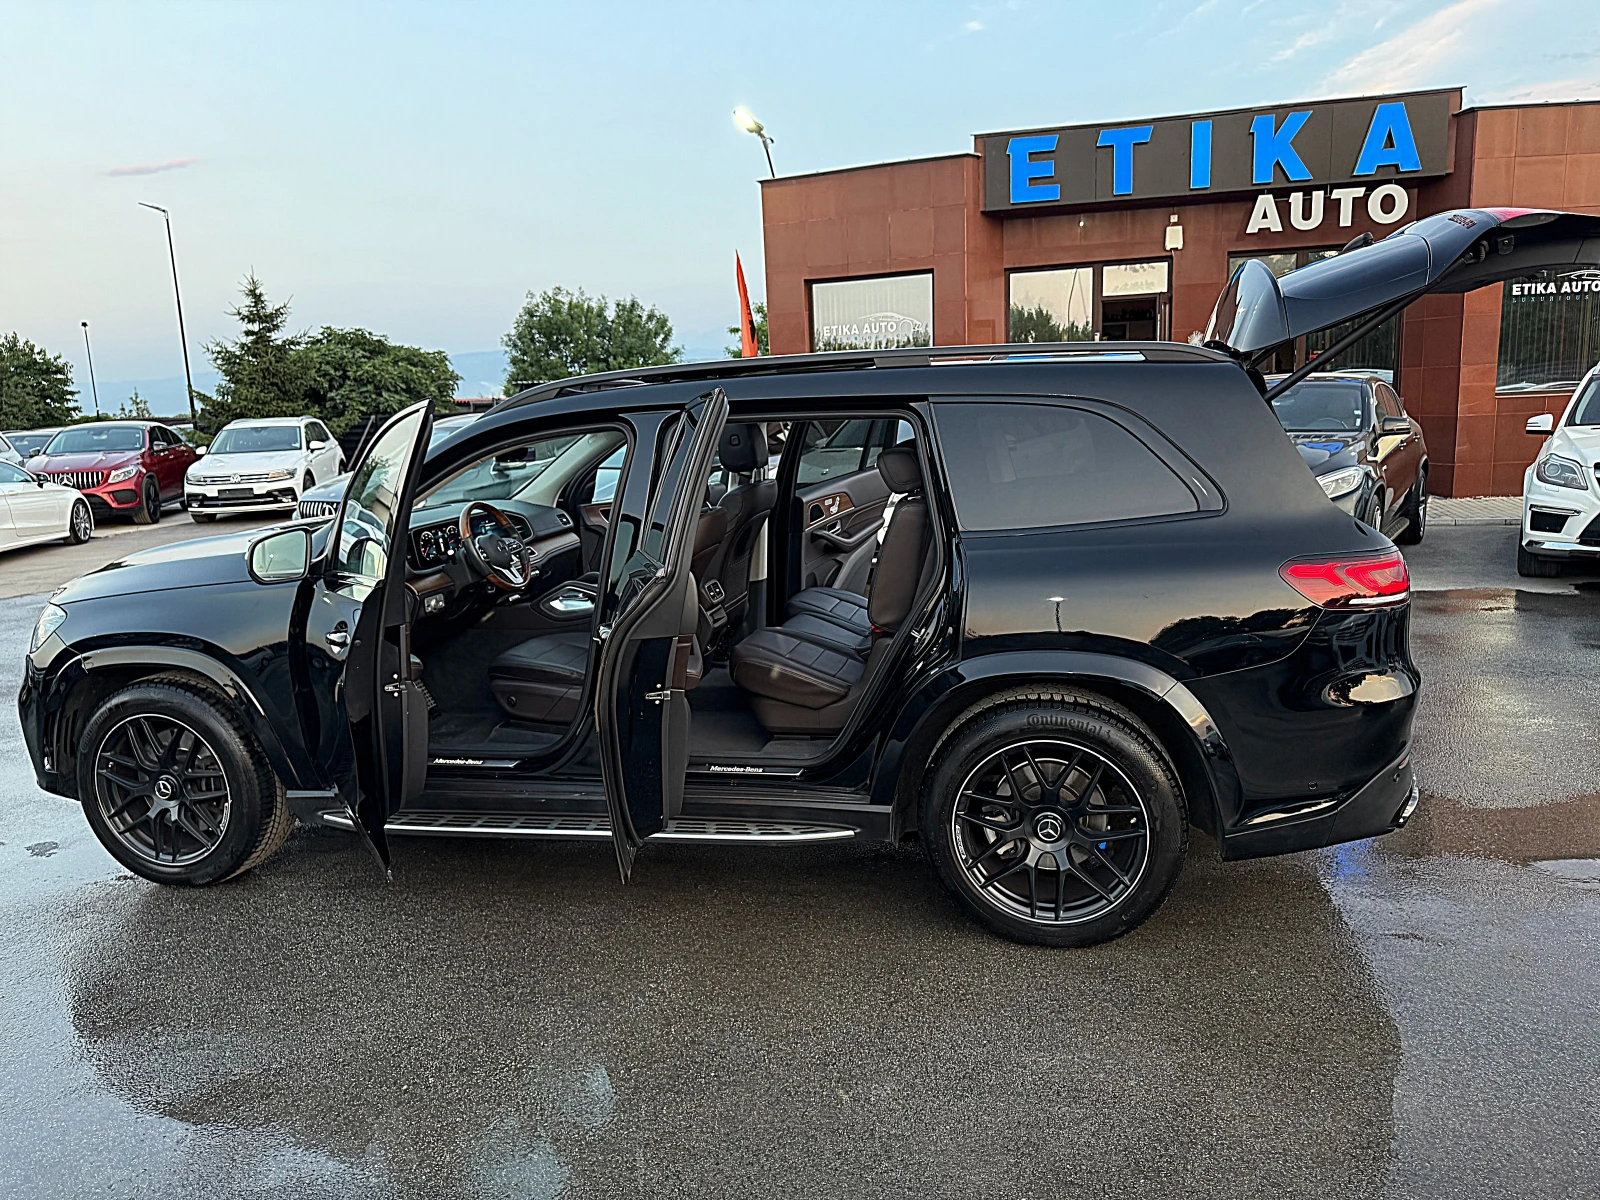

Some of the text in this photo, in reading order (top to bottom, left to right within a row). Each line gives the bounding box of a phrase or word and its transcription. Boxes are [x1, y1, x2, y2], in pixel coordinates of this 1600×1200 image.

[1006, 102, 1422, 203] ETIKA
[1246, 184, 1409, 234] AUTO
[1512, 280, 1600, 295] ETIKA AUTO
[1512, 295, 1589, 303] LUXURIOUS
[823, 321, 896, 336] ETIKA AUTO
[1026, 713, 1103, 736] Continental
[709, 765, 764, 773] Mercedes-Benz
